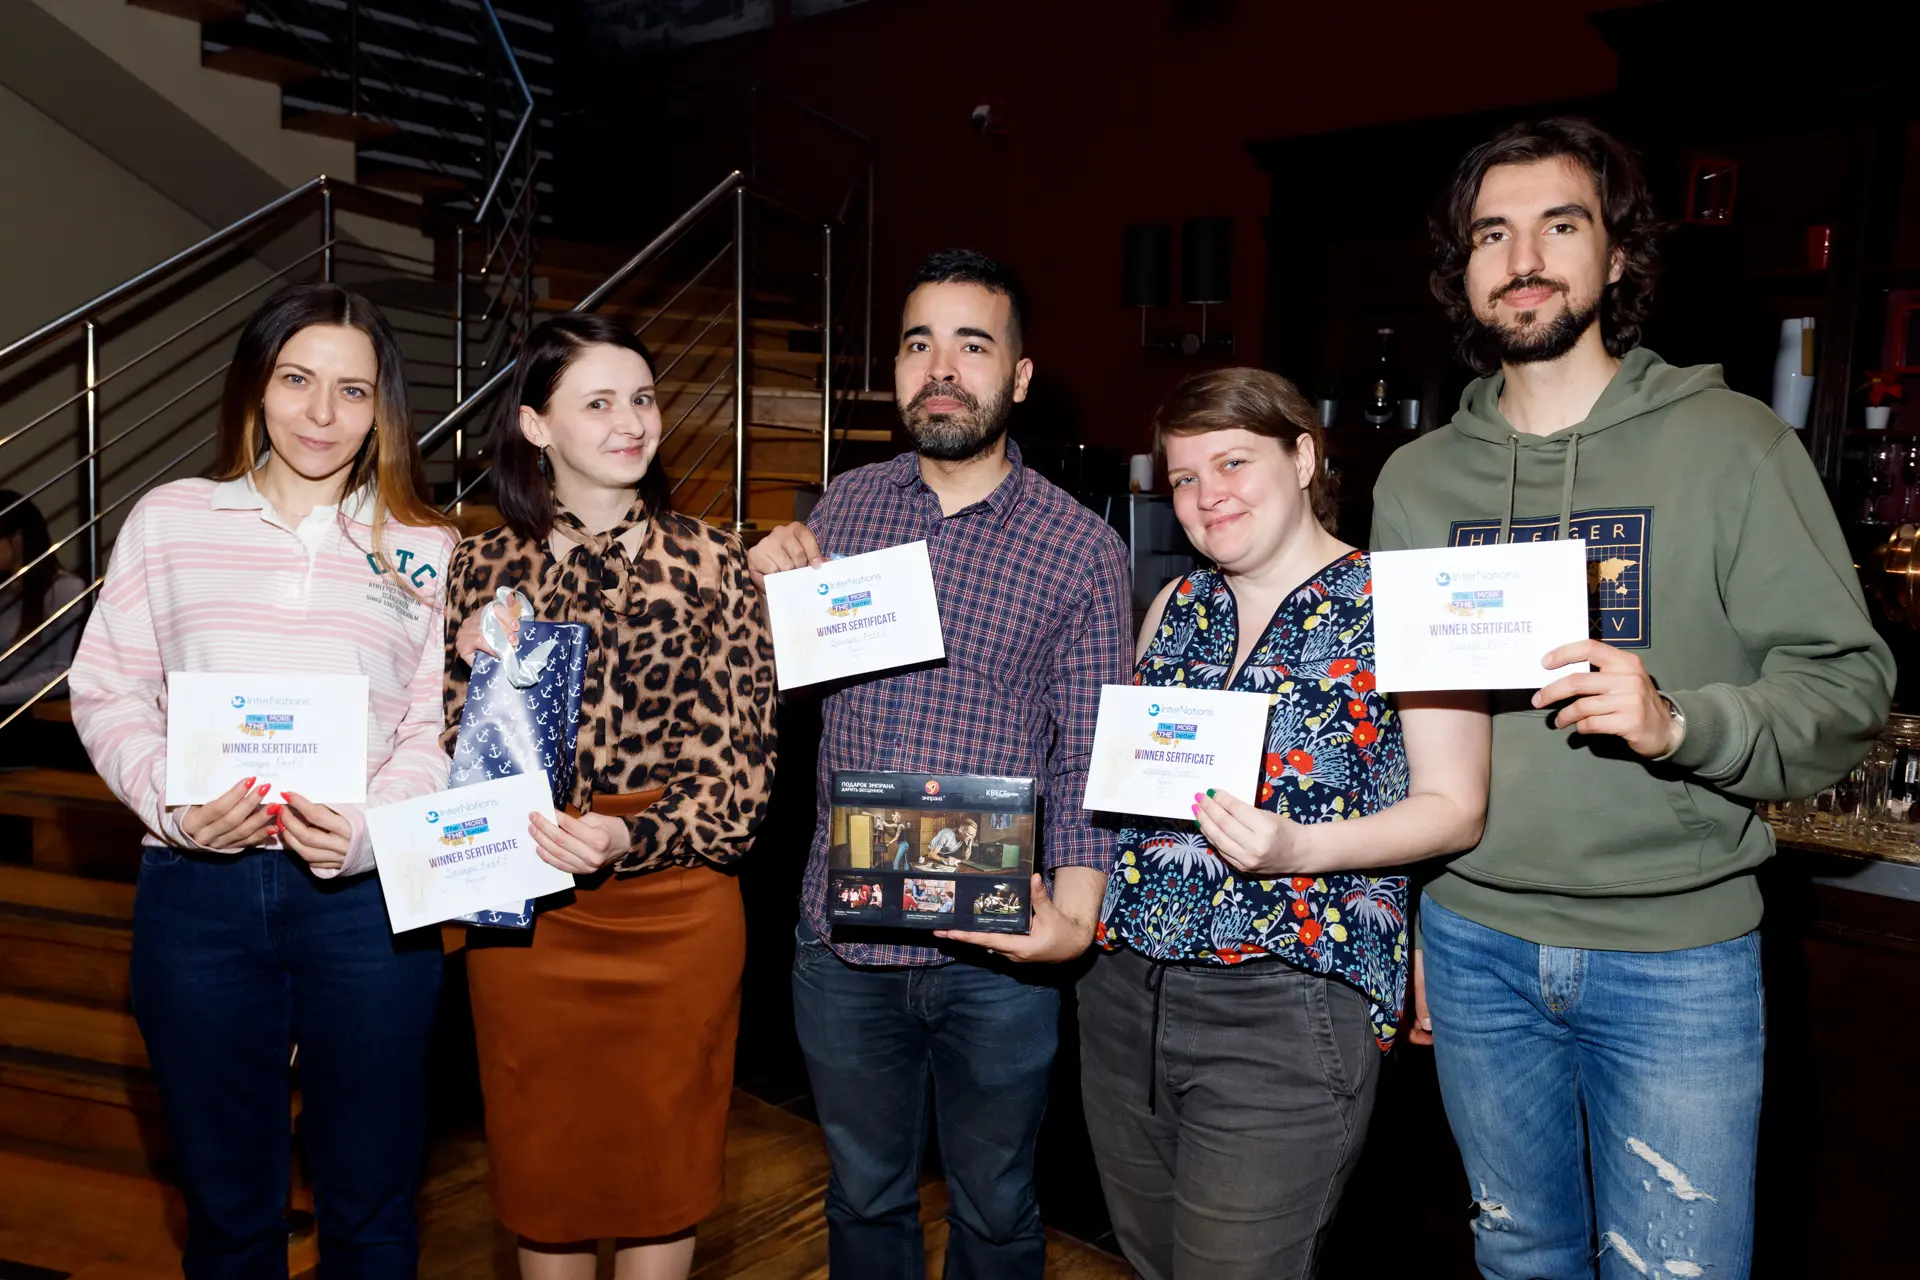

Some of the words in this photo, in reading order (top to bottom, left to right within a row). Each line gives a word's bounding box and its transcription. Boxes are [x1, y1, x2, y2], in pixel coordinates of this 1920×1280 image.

[829, 573, 882, 591] InterNations
[1452, 570, 1520, 582] InterNations
[850, 592, 869, 600] MORE
[816, 622, 848, 637] WINNER
[848, 612, 897, 631] SERTIFICATE
[1429, 623, 1468, 636] WINNER
[1470, 620, 1533, 635] SERTIFICATE
[247, 695, 310, 706] InterNations
[1161, 704, 1214, 716] InterNations
[1176, 724, 1196, 732] MORE
[222, 742, 259, 754] WINNER
[261, 742, 319, 754] SERTIFICATE
[1134, 749, 1165, 762] WINNER
[1165, 751, 1216, 766] SERTIFICATE
[841, 781, 868, 789] ПОДАРОК
[440, 798, 498, 817] InterNations
[465, 819, 485, 828] MORE
[429, 851, 464, 868] WINNER
[464, 839, 519, 860] SERTIFICATE
